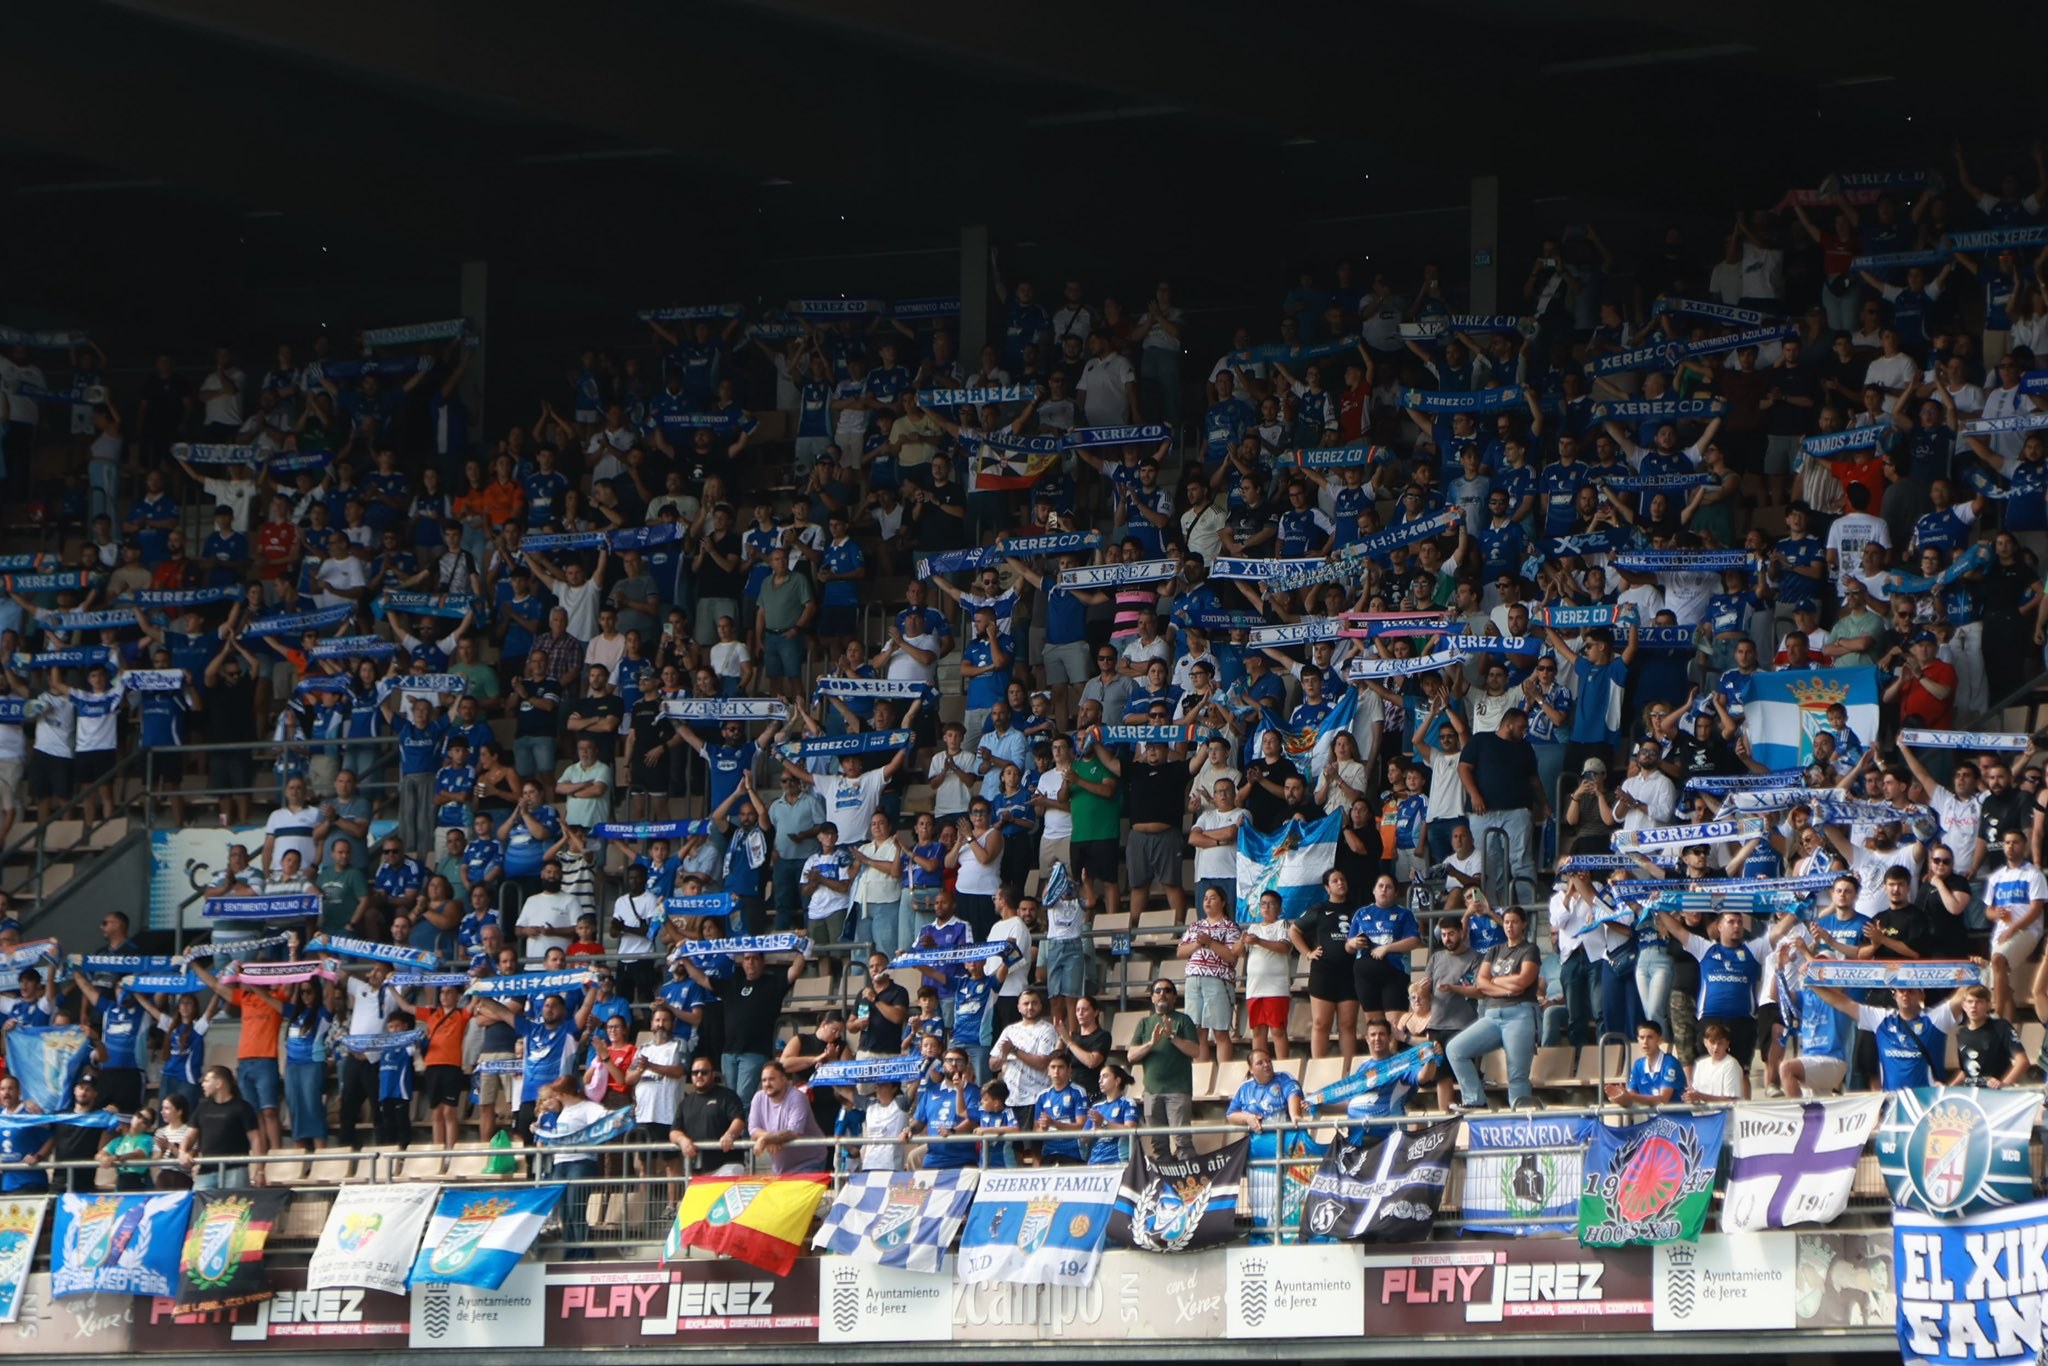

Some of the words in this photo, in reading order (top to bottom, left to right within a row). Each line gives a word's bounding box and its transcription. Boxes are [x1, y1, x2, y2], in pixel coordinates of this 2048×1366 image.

[1955, 231, 1999, 248] VAMOS
[2002, 227, 2042, 245] XEREZ
[804, 301, 842, 313] XEREZ
[847, 301, 865, 312] CD
[1685, 301, 1734, 318] XEREZ
[1737, 311, 1760, 323] CD
[1451, 315, 1490, 327] XEREZ
[1687, 335, 1739, 351] SENTIMIENTO
[1741, 327, 1776, 341] AZULINO
[1602, 349, 1655, 371] XEREZ
[934, 390, 1019, 405] XEREZ
[1426, 397, 1457, 406] XEREZ
[1613, 401, 1676, 415] XEREZ
[1092, 427, 1140, 442] XEREZ
[1142, 425, 1162, 438] CD
[1806, 435, 1844, 453] VAMOS
[1307, 450, 1344, 463] XEREZ
[1346, 449, 1362, 462] CD
[1655, 474, 1701, 485] DEPORT
[1009, 537, 1058, 551] XEREZ
[1058, 535, 1081, 546] CD
[1554, 533, 1608, 555] Xerez
[1650, 555, 1679, 566] CLUB
[1682, 555, 1746, 566] DEPORTIVO
[17, 574, 56, 588] XEREZ
[57, 573, 76, 585] CD
[1090, 567, 1150, 583] XEREZ
[140, 590, 194, 603] XEREZ
[391, 594, 428, 603] XEREZ
[62, 611, 103, 626] VAMOS
[1555, 610, 1590, 624] XEREZ
[1592, 608, 1608, 623] CD
[1276, 622, 1334, 640] XERE
[1447, 636, 1497, 649] XEREZ
[1502, 636, 1525, 650] CD
[683, 701, 754, 715] XEREZ
[1108, 725, 1154, 740] XEREZ
[1160, 724, 1179, 738] CD
[1931, 733, 2003, 746] XEREZ
[806, 741, 842, 751] XEREZ
[843, 740, 859, 749] CD
[1642, 826, 1703, 844] XEREZ
[1707, 823, 1733, 838] CD
[668, 898, 704, 908] XEREZ
[705, 898, 721, 908] CD
[331, 936, 373, 954] VAMOS
[374, 944, 415, 960] XEREZ
[686, 940, 706, 952] EL
[755, 936, 790, 949] FANS
[1113, 940, 1128, 950] 212
[87, 955, 124, 965] XEREZ
[924, 951, 953, 960] CLUB
[138, 976, 171, 986] XEREZ
[1833, 968, 1875, 979] XEREZ
[1912, 969, 1952, 980] XEREZ
[846, 1066, 870, 1077] CLUB
[1834, 1112, 1868, 1135] XCD
[1480, 1126, 1574, 1147] FRESNEDA
[1882, 1143, 1896, 1154] 1947
[984, 1177, 1051, 1194] SHERRY
[1055, 1176, 1113, 1194] FAMILY
[1584, 1173, 1618, 1200] 19
[1681, 1170, 1714, 1193] 47
[375, 1259, 398, 1274] azul
[1903, 1235, 1954, 1300] EL
[1703, 1269, 1783, 1284] Ayuntamiento
[1274, 1278, 1351, 1295] Ayuntamiento
[1382, 1266, 1486, 1304] PLAY
[1465, 1252, 1605, 1322] JEREZ
[1703, 1286, 1716, 1298] de
[1719, 1286, 1748, 1301] Jerez
[457, 1295, 532, 1310] Ayuntamiento
[866, 1287, 940, 1304] Ayuntamiento
[1121, 1272, 1140, 1323] SIN
[561, 1285, 661, 1318] PLAY
[641, 1272, 775, 1335] JEREZ
[866, 1304, 879, 1315] de
[880, 1304, 907, 1317] Jerez
[1274, 1296, 1286, 1307] de
[1288, 1296, 1318, 1311] Jerez
[231, 1291, 366, 1341] JEREZ
[457, 1311, 470, 1321] de
[471, 1311, 498, 1324] Jerez
[1903, 1300, 2048, 1359] FAN
